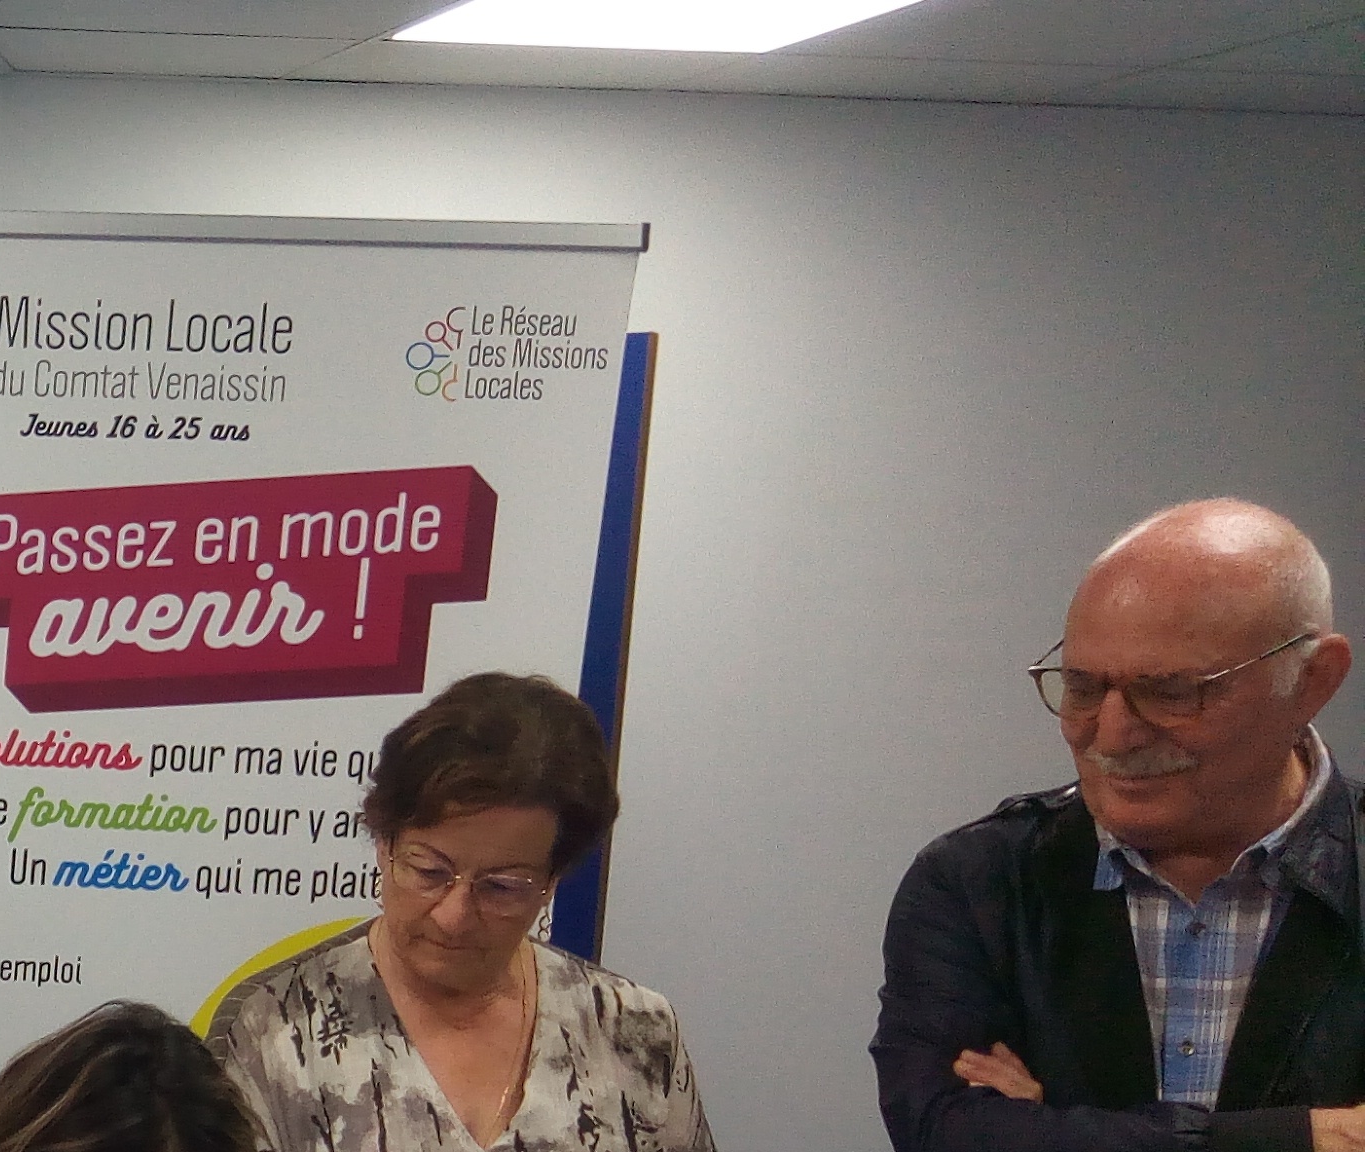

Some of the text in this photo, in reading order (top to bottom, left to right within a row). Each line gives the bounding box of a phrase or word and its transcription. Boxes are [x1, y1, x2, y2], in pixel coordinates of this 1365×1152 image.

[167, 299, 294, 355] Locale
[471, 305, 578, 337] Le Réseau
[468, 337, 609, 370] des Missions
[34, 359, 140, 400] Comtat
[148, 361, 287, 403] Venaissin
[463, 368, 544, 400] Locales
[19, 413, 251, 442] Jeunes 16 à 25 ans
[194, 514, 259, 565] en
[279, 491, 442, 560] mode
[28, 555, 371, 658] avenir !
[149, 743, 225, 777] pour
[234, 746, 282, 775] ma
[293, 740, 338, 777] vie
[7, 786, 218, 844] formation
[224, 806, 300, 841] pour
[309, 809, 325, 844] y
[9, 848, 46, 886] Un
[51, 849, 190, 892] métier
[196, 858, 242, 899] qui
[252, 866, 302, 896] me
[0, 954, 83, 988] emploi
